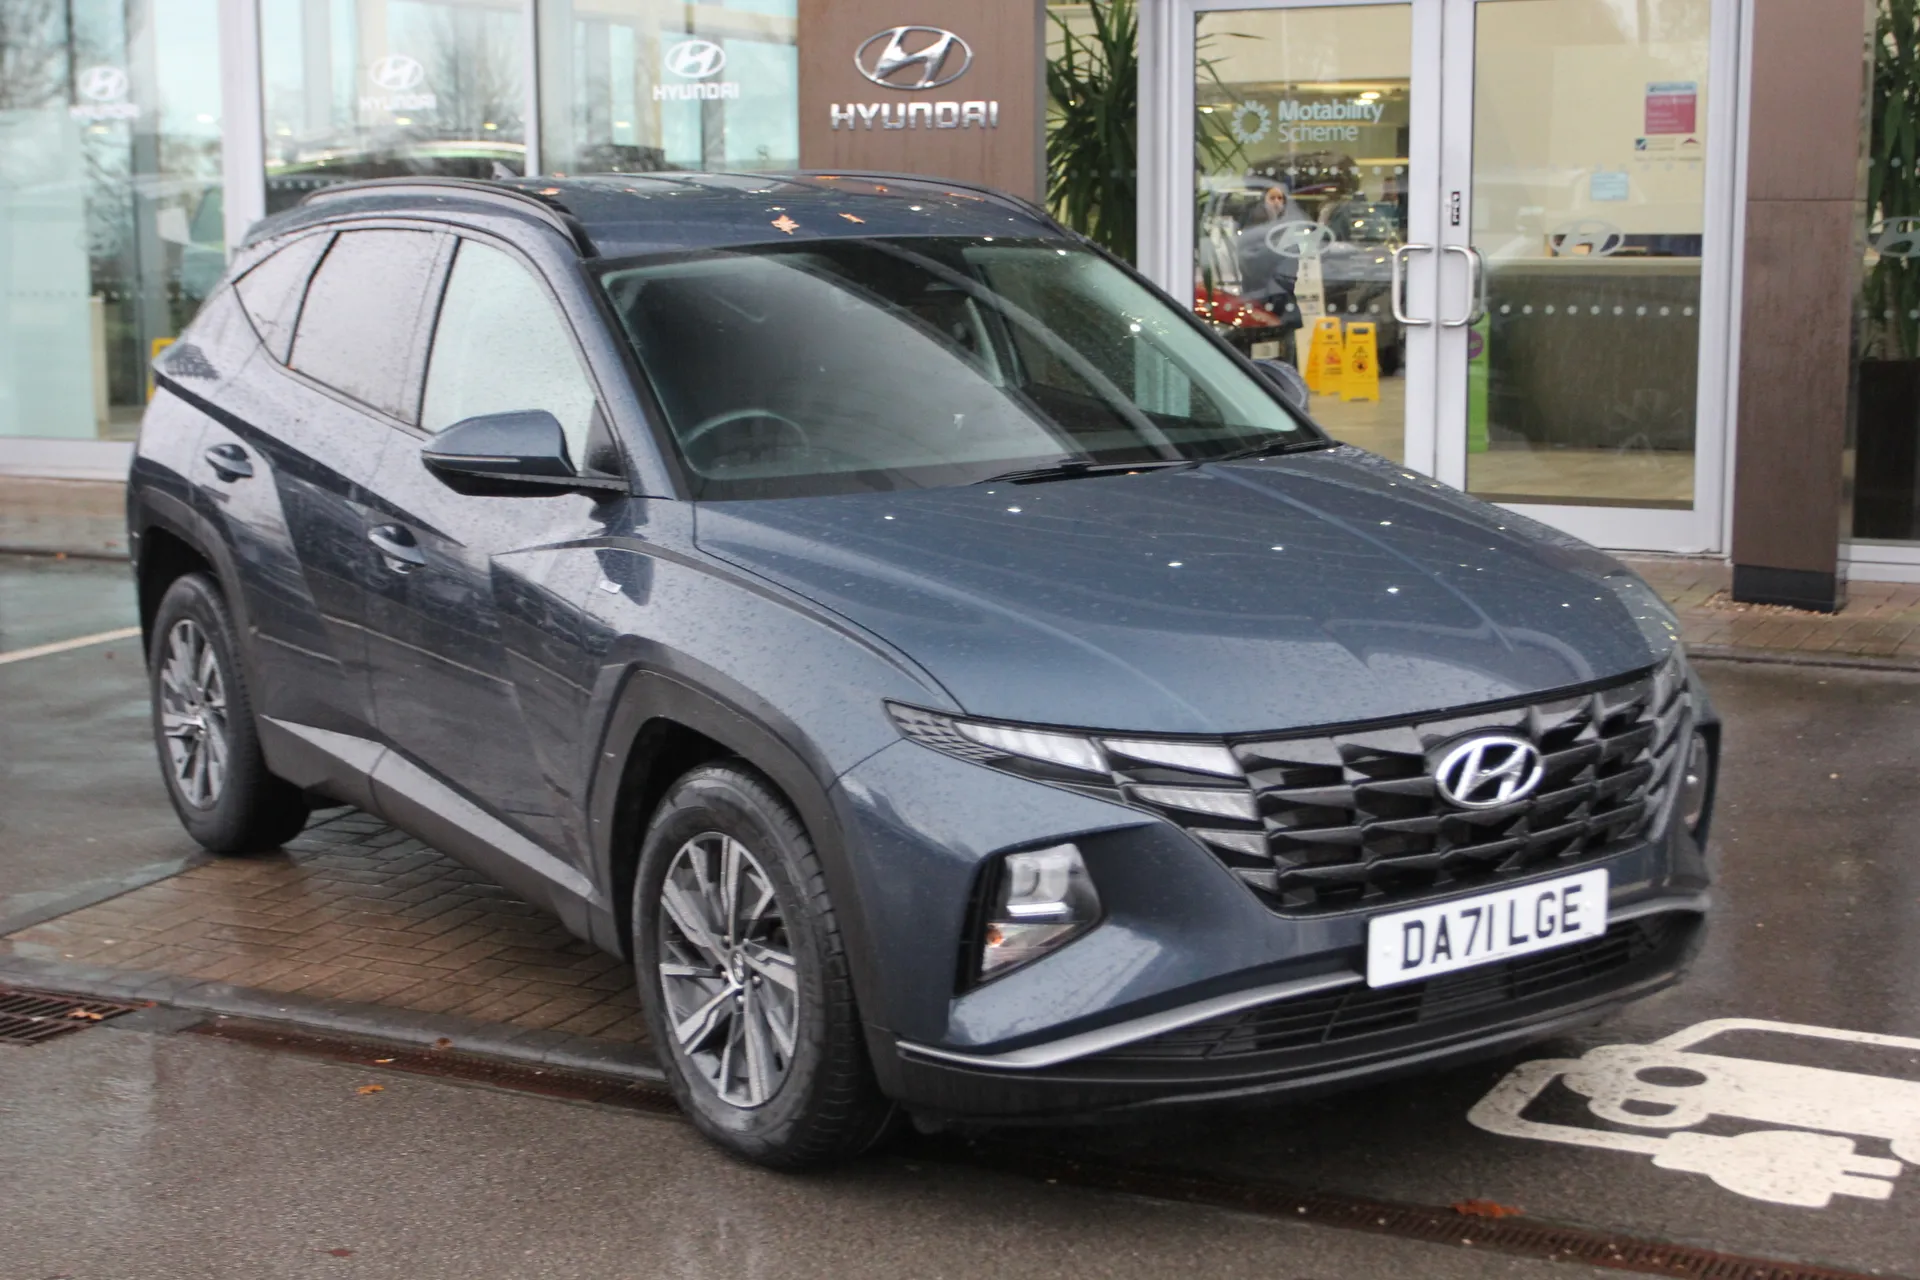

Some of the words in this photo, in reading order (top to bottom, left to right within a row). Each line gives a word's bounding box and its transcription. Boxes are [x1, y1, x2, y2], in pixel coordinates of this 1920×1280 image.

[653, 82, 739, 100] HYUNDAI
[830, 101, 998, 129] HYUNDAI
[1278, 100, 1384, 123] Motability
[1278, 123, 1359, 142] Scheme
[1400, 904, 1495, 970] DA71
[1508, 884, 1582, 946] LGE
